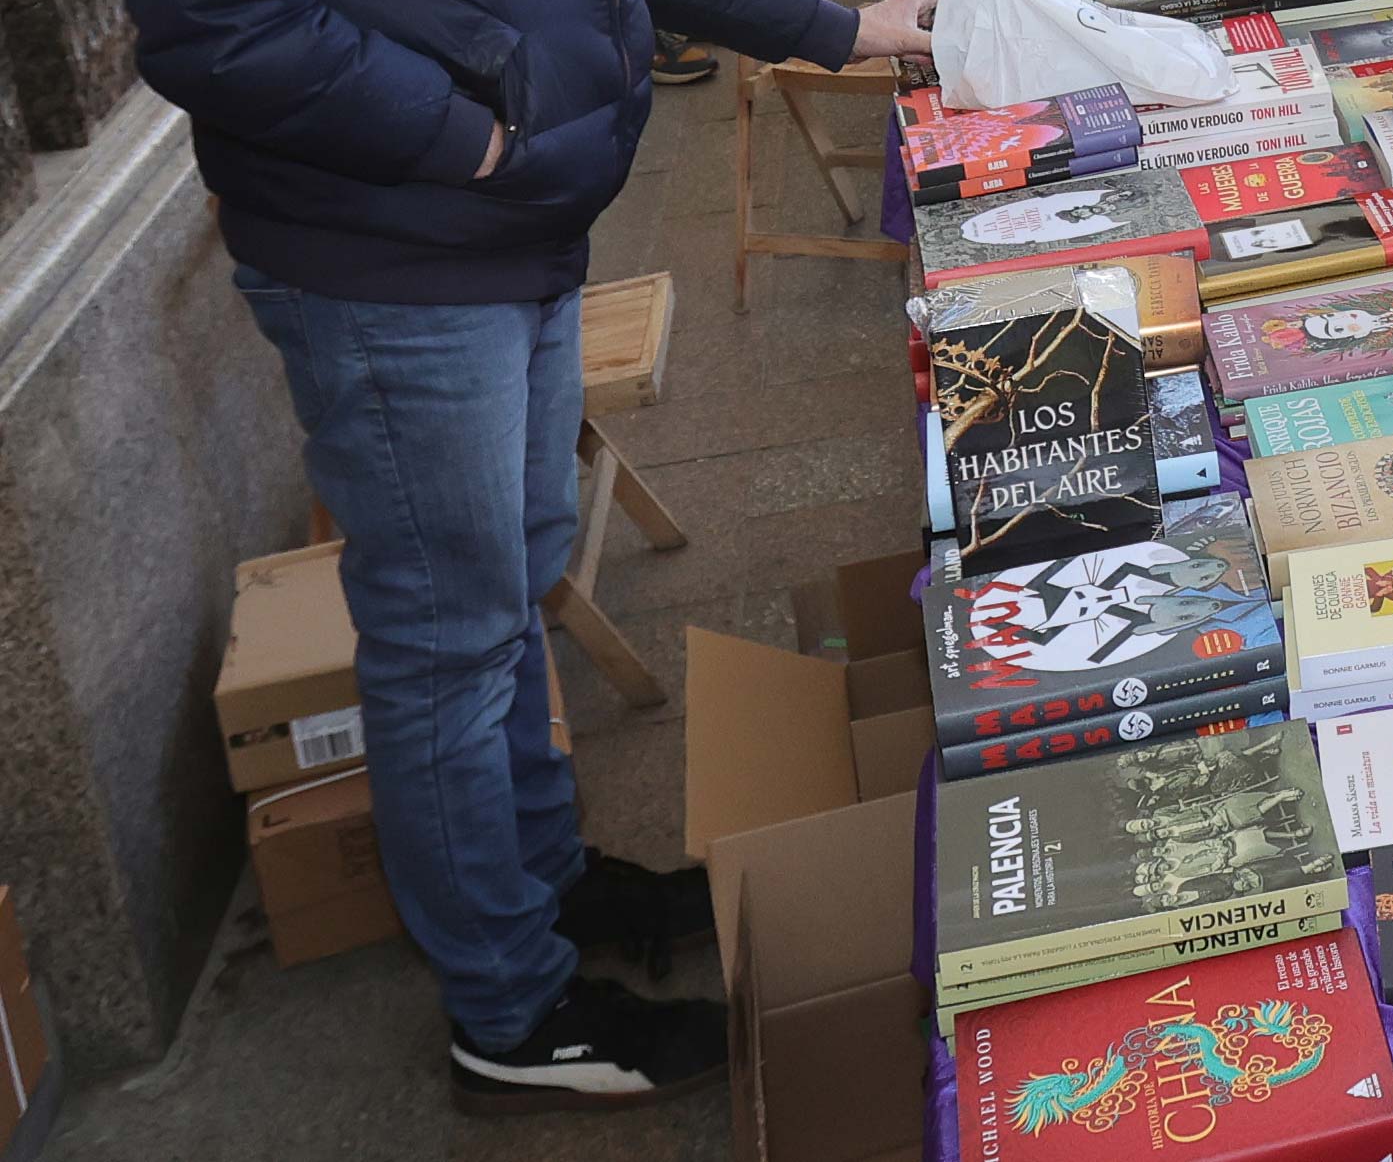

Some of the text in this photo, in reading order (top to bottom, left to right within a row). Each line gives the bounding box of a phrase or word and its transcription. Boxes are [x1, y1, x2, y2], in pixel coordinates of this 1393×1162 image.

[1269, 48, 1314, 94] TONI HILL
[1148, 114, 1188, 136] ÚLTIMO
[1191, 111, 1243, 129] VERDUGO
[1250, 106, 1276, 121] TONI
[1278, 103, 1302, 117] HILL
[1140, 134, 1307, 171] EL ÚLTIMO VERDUGO TONI HILL
[1248, 162, 1260, 170] LA
[1211, 164, 1243, 212] MUJERES
[1257, 192, 1269, 203] DE
[1274, 155, 1305, 199] GUERRA
[1209, 313, 1253, 381] Frida Kahlo
[1263, 384, 1287, 396] Frida
[1018, 401, 1075, 434] LOS
[1257, 402, 1294, 455] NRIQUE
[1285, 395, 1336, 452] ROJAS
[958, 426, 1143, 481] HABITANTES
[992, 465, 1122, 511] DEL AIRE
[1284, 457, 1327, 536] NORWICH
[1315, 450, 1363, 531] BIZANCIO
[1311, 572, 1329, 620] LECCIONES
[1329, 607, 1342, 620] DE
[954, 582, 1041, 690] MAUS
[1323, 662, 1353, 676] BONNIE
[1353, 659, 1386, 672] GARMUS
[974, 692, 1107, 736] MAUS
[1313, 696, 1343, 710] BONNIE
[1343, 694, 1377, 707] GARMUS
[980, 726, 1111, 770] MAUS
[1366, 787, 1376, 798] en
[1366, 799, 1377, 818] vida
[1371, 819, 1381, 835] La
[988, 795, 1026, 917] PALENCIA
[1178, 898, 1287, 934] PALENCIA
[1174, 925, 1280, 955] PALENCIA
[1277, 980, 1289, 990] El
[1285, 950, 1303, 987] de una de
[1298, 947, 1319, 990] las grandes
[1311, 944, 1334, 994] civilizaciones
[1325, 941, 1348, 990] de la historia
[976, 1028, 994, 1086] WOOD
[1146, 976, 1218, 1144] CHINA
[1144, 1082, 1164, 1150] HISTORIA DE
